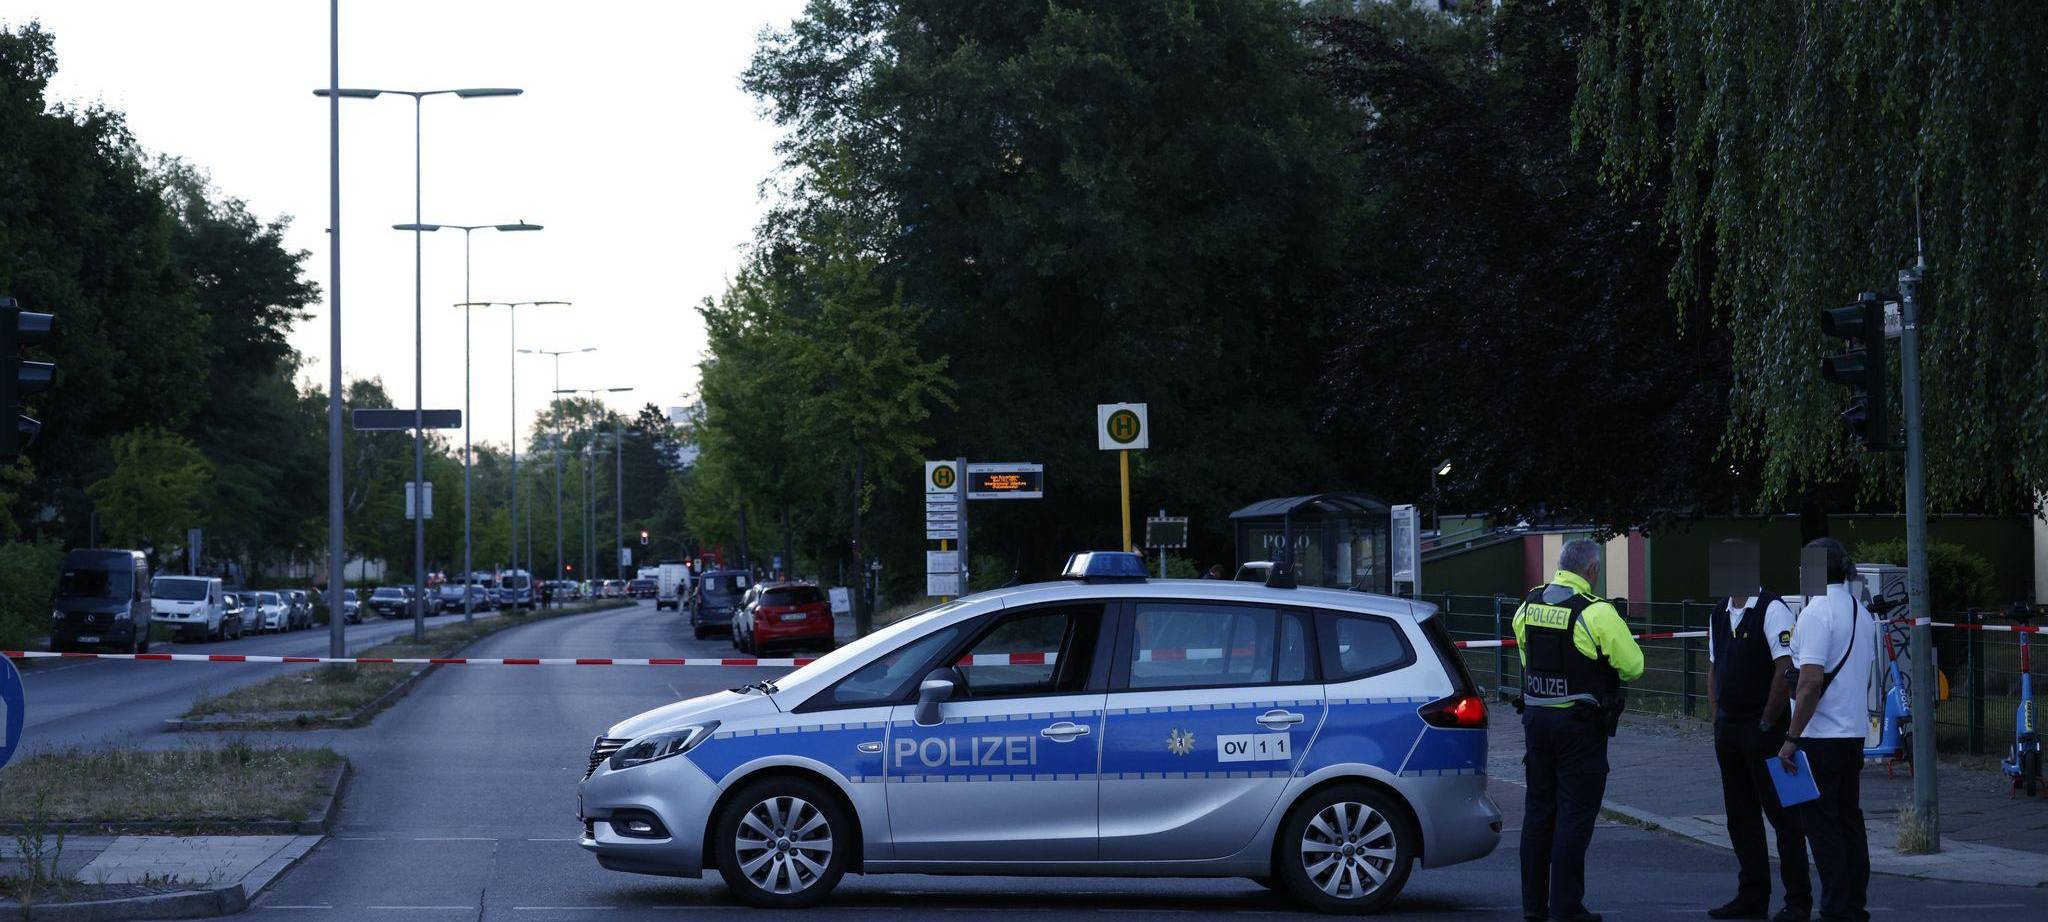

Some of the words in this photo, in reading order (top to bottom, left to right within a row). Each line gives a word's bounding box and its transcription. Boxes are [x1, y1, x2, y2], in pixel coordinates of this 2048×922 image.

[1527, 606, 1567, 625] POLIZEI
[1527, 675, 1568, 696] POLIZEI
[894, 736, 1038, 768] POLIZEI
[1224, 741, 1247, 755] OV
